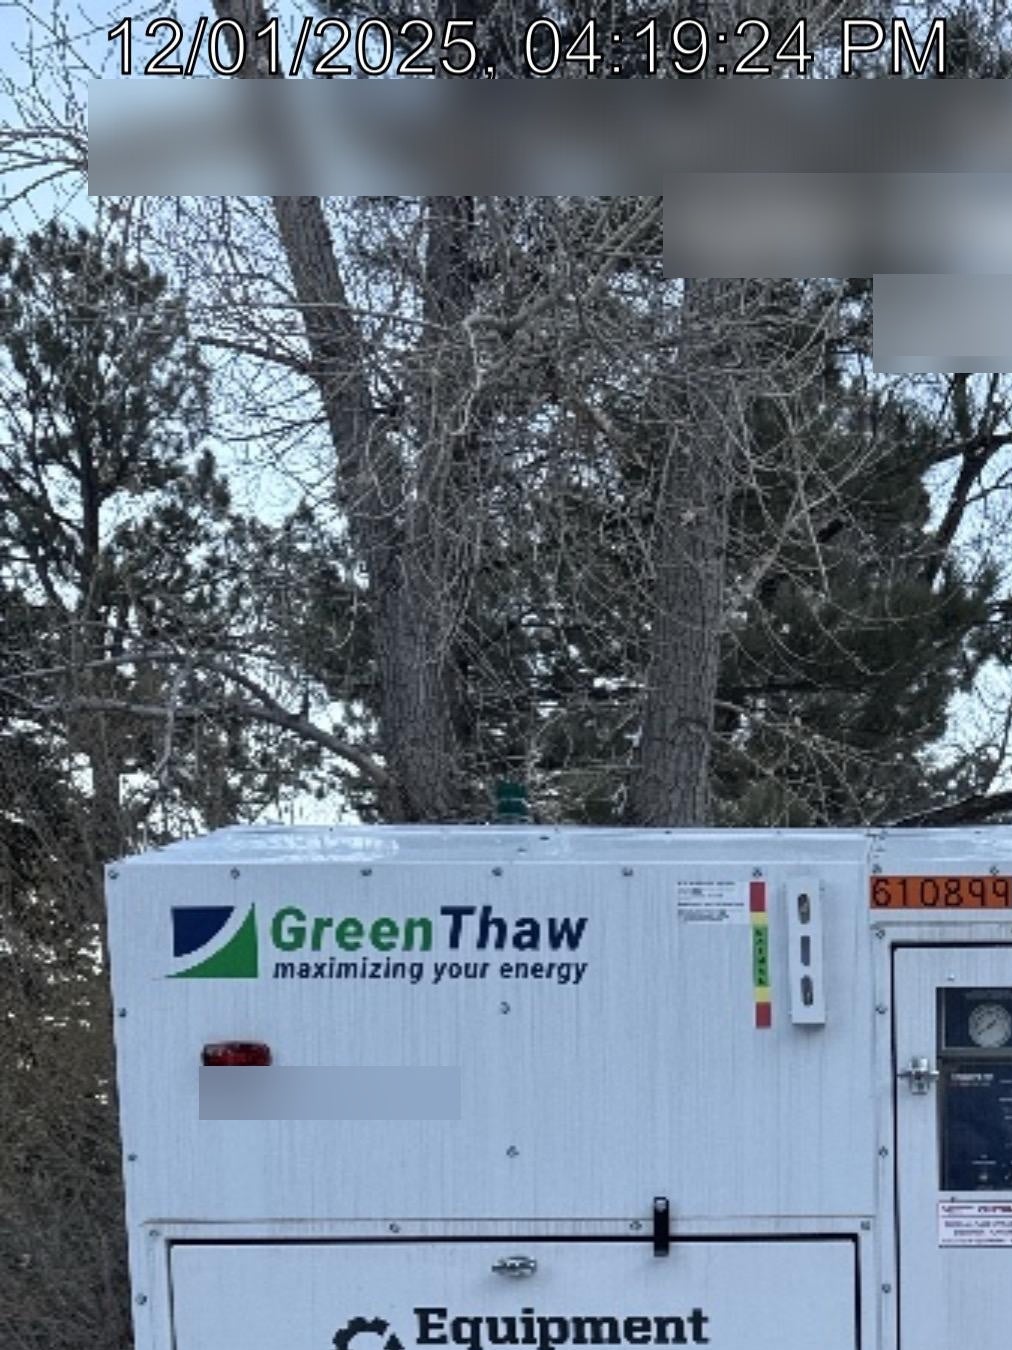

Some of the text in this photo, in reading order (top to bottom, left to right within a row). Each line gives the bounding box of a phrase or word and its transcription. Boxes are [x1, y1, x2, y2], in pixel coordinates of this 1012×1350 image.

[872, 878, 1009, 906] 610899
[273, 957, 588, 984] maximizing your energy
